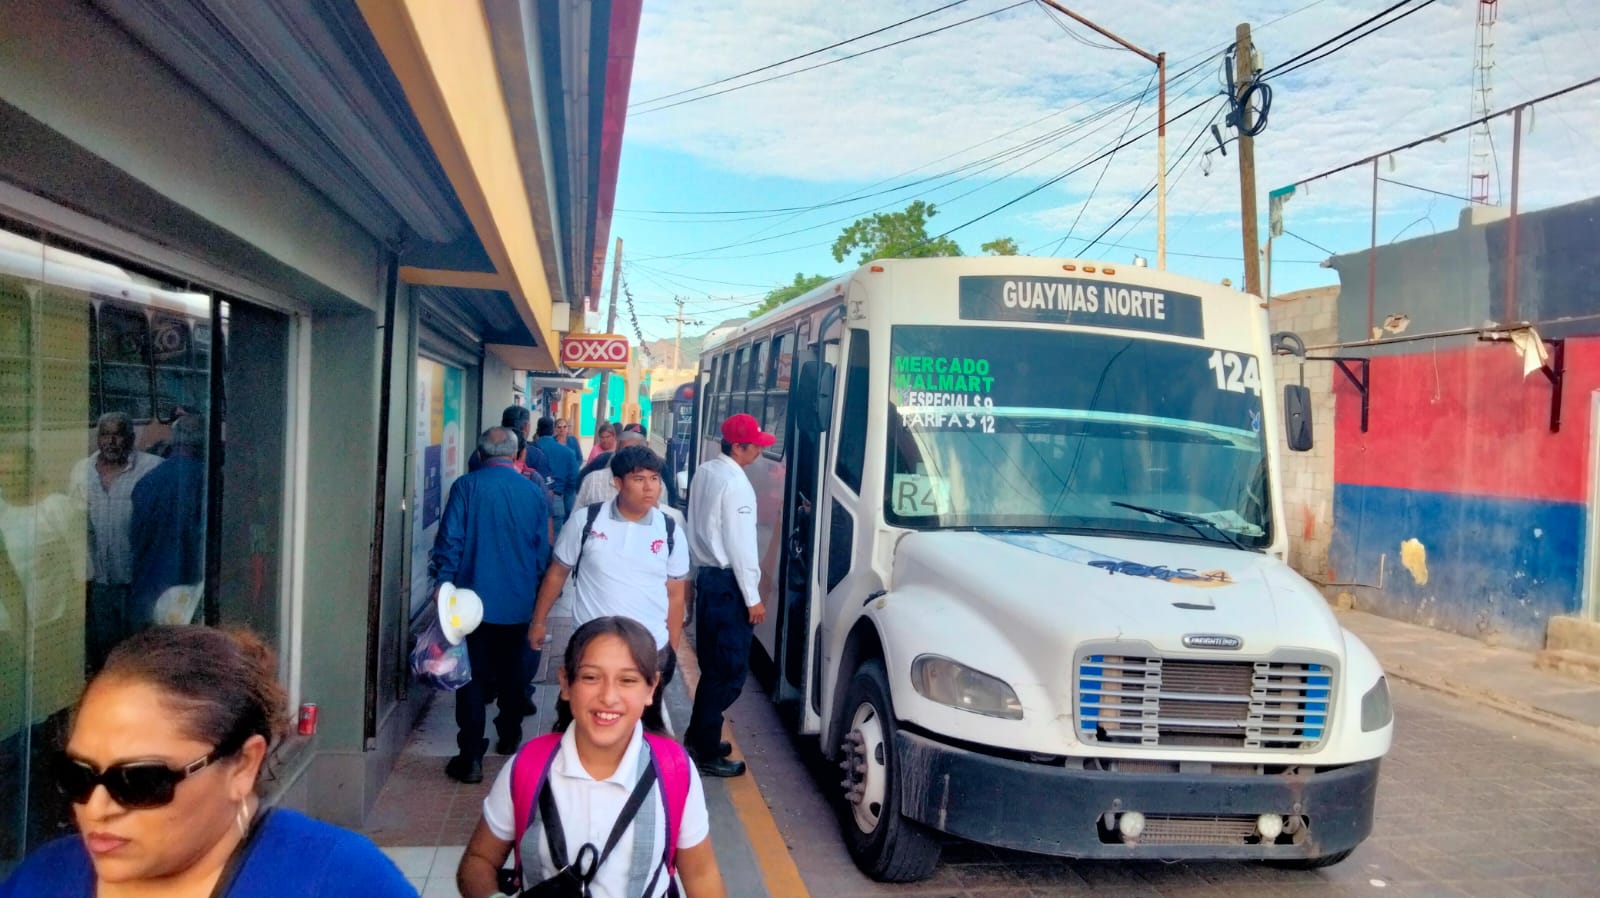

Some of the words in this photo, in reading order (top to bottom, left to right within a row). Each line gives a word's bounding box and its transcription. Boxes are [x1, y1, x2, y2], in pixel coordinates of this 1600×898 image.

[1003, 280, 1099, 313] GUAYMAS
[1104, 287, 1166, 320] NORTE
[565, 339, 627, 363] OXXO
[895, 356, 989, 376] MERCADO
[1208, 349, 1261, 397] 124
[895, 374, 995, 393] WALMART
[901, 411, 963, 428] TARIFA
